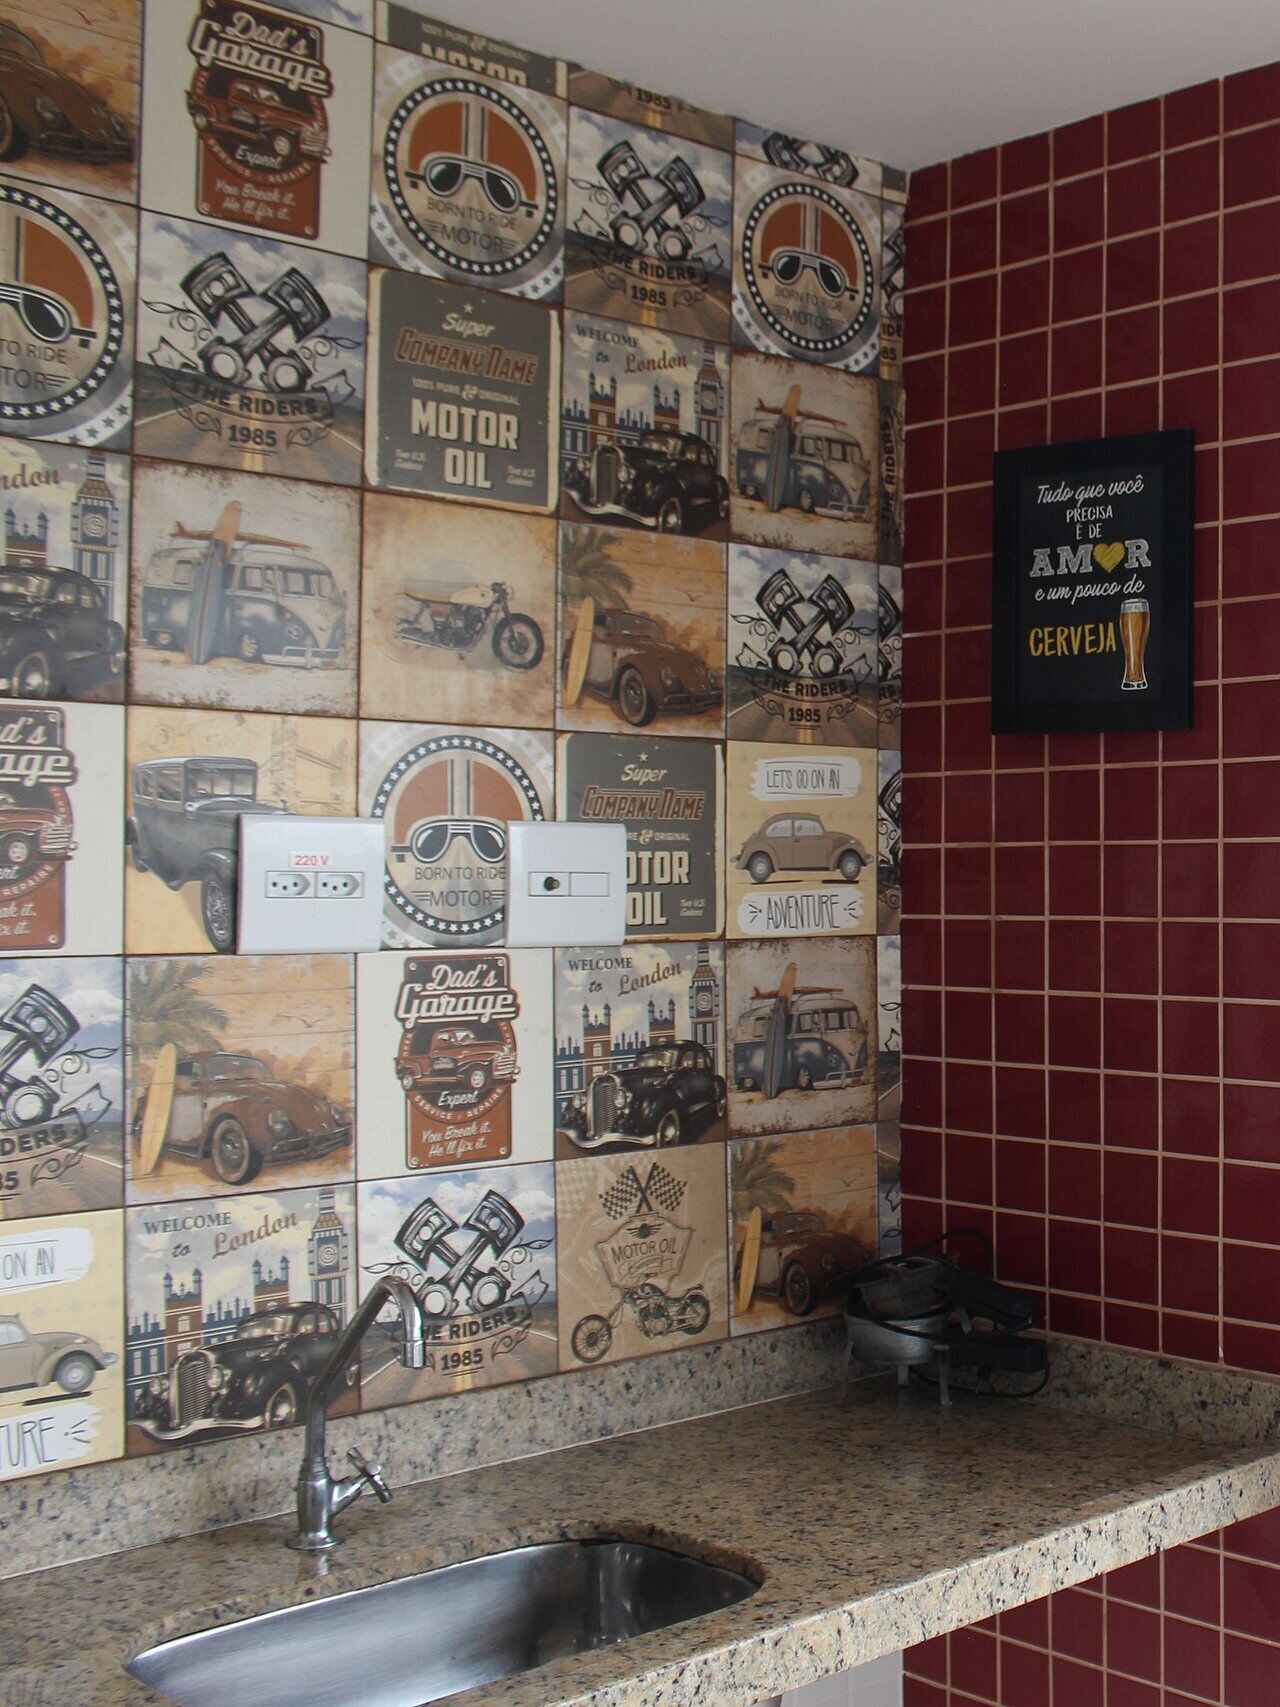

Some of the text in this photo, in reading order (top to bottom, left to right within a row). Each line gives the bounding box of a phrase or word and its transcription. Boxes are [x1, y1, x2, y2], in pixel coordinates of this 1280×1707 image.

[226, 12, 308, 54] Dad's
[192, 19, 328, 90] Garage
[639, 260, 697, 281] RIDERS
[631, 285, 667, 306] 1985
[442, 313, 495, 338] Super
[576, 324, 640, 349] WELCOME
[27, 343, 67, 364] RIDE
[394, 327, 485, 376] COMPANY
[624, 350, 688, 374] London
[239, 396, 317, 416] RIDERS
[228, 423, 277, 447] 1985
[411, 398, 519, 450] MOTOR
[444, 447, 492, 489] OIL
[1037, 474, 1145, 507] Tudo que você
[1066, 505, 1114, 523] PRECISA
[1088, 523, 1102, 539] DE
[1035, 573, 1145, 606] e um pouco de
[1029, 621, 1117, 657] CERVEJA
[795, 680, 847, 697] RIDERS
[788, 707, 821, 722] 1985
[621, 764, 667, 785] Super
[766, 769, 793, 789] LETS
[811, 769, 825, 789] ON
[828, 768, 840, 789] AN
[580, 785, 659, 820] COMPANY
[639, 829, 654, 845] &
[294, 854, 329, 867] 220 V
[626, 850, 690, 885] OTOR
[415, 867, 506, 880] BORN TO RIDE
[429, 889, 492, 907] MOTOR
[626, 891, 667, 925] OIL
[767, 894, 840, 930] ADVENTURE
[568, 956, 633, 972] WELCOME
[425, 964, 498, 990] Dad's
[588, 961, 682, 997] to London
[397, 983, 516, 1029] Garage
[437, 1090, 480, 1108] Expert
[143, 1211, 232, 1235] WELCOME
[171, 1212, 299, 1259] to London
[3, 1246, 54, 1280] ON AN
[611, 1237, 677, 1264] MOTOR OIL
[449, 1307, 518, 1340] RIDERS
[441, 1348, 483, 1370] 1985
